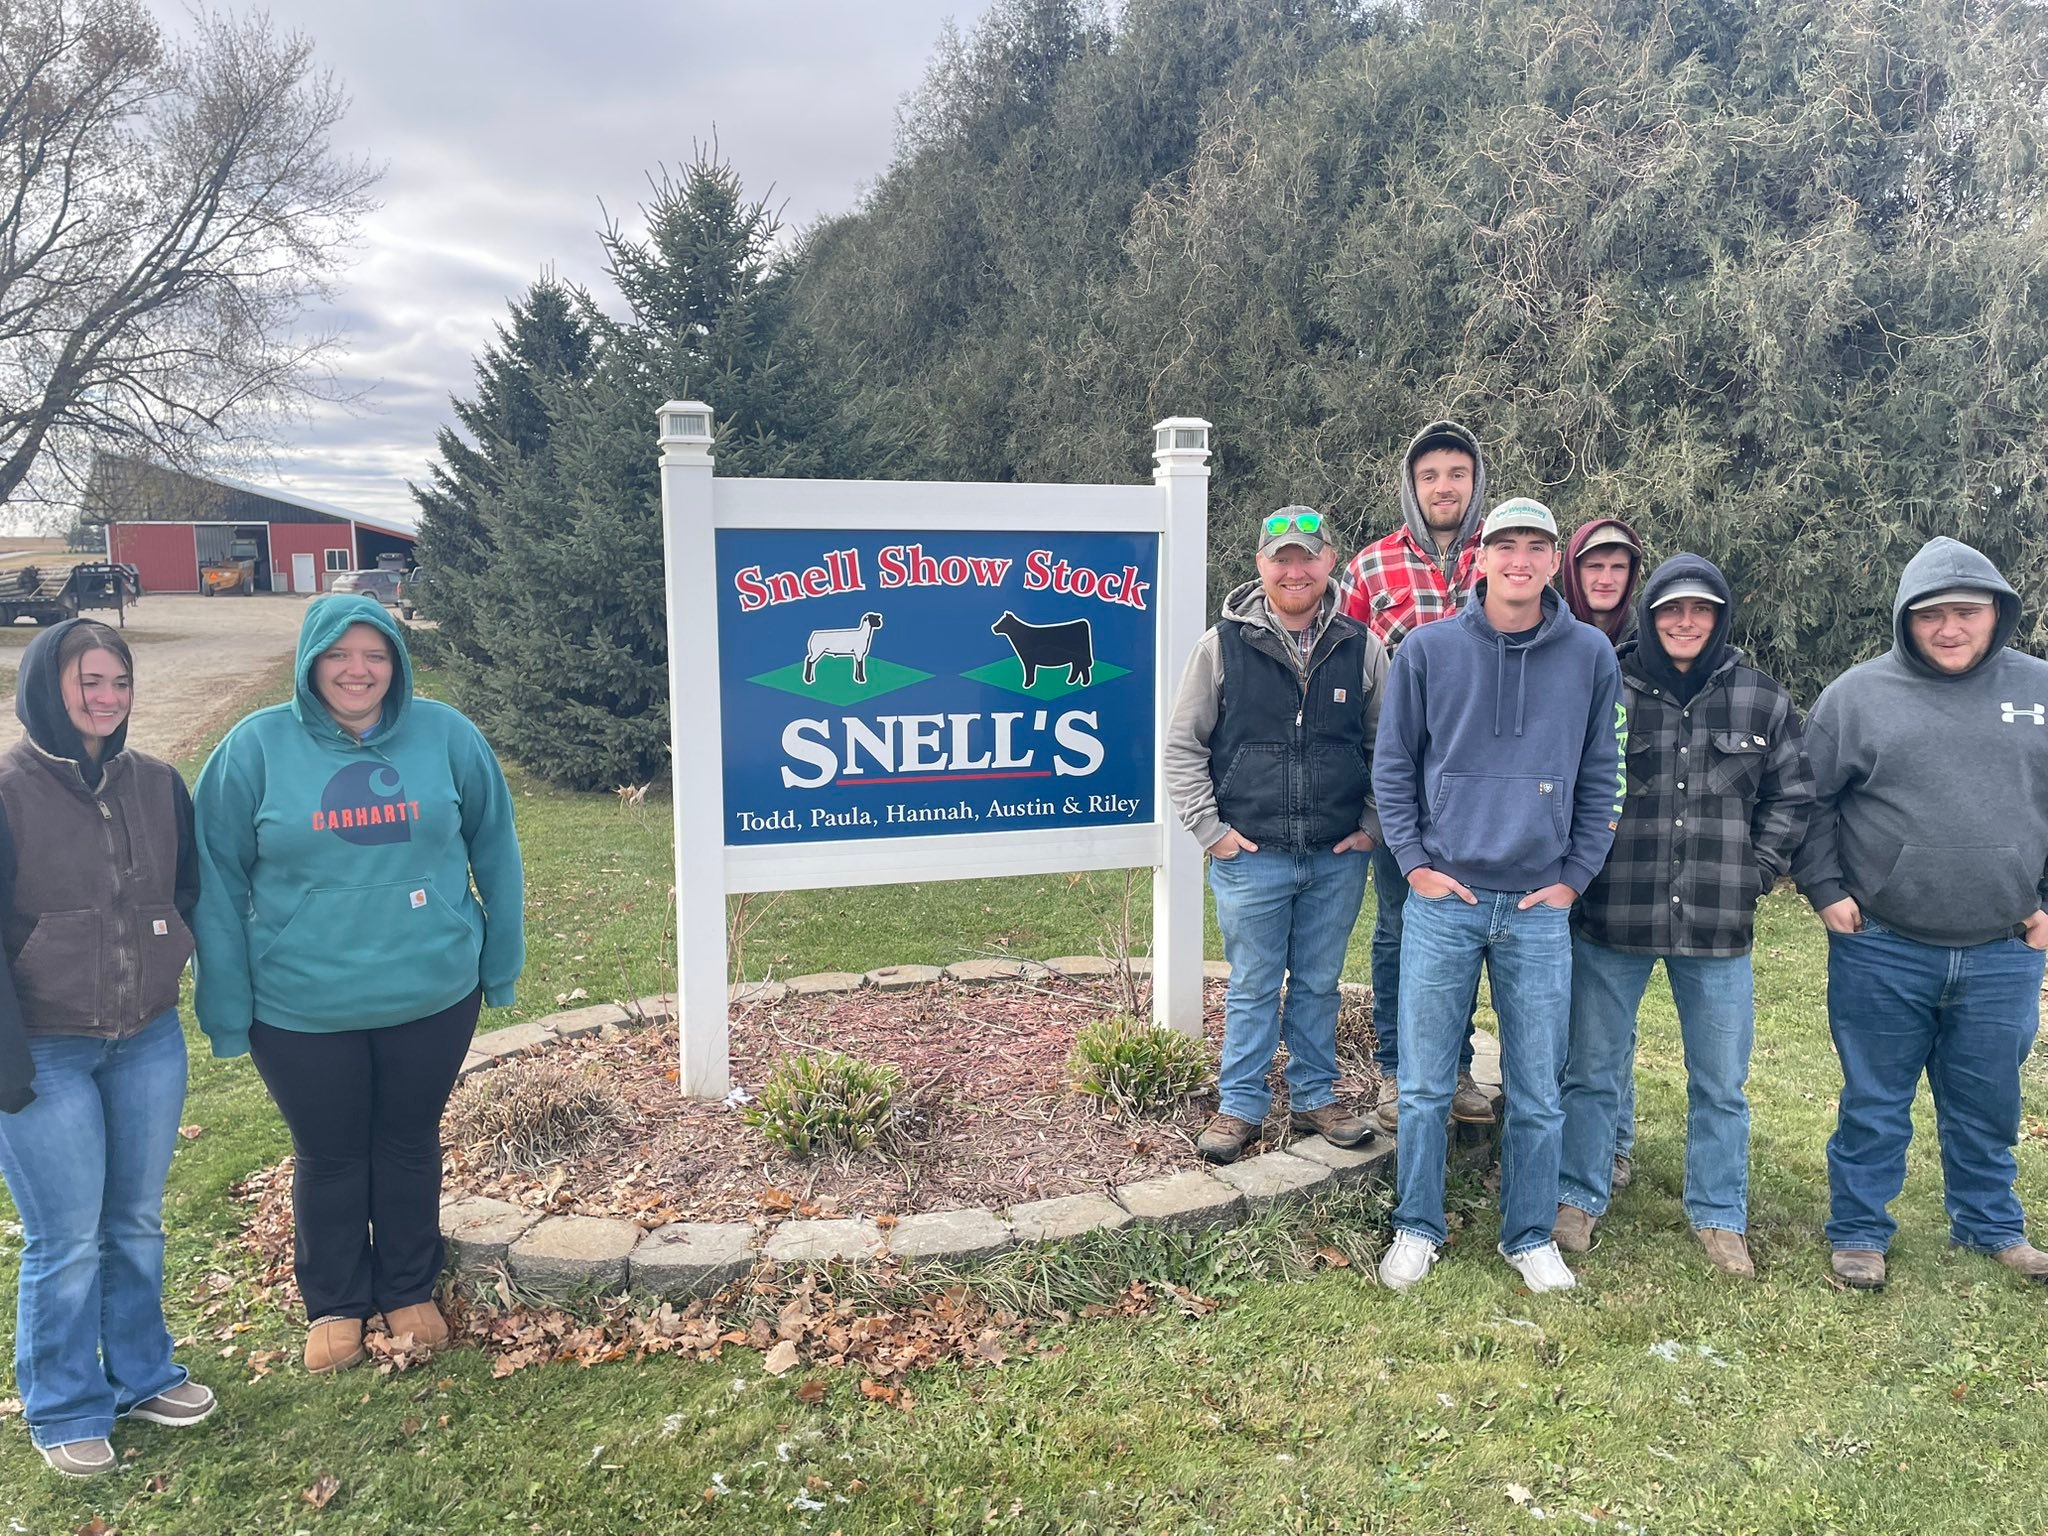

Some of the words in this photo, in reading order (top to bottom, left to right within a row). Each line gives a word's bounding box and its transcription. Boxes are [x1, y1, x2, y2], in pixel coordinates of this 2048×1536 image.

[735, 548, 866, 612] Snell
[878, 543, 1012, 588] Show
[1023, 550, 1150, 610] Stock
[780, 710, 1105, 789] SNELL'S
[312, 801, 419, 831] CARHARTT
[737, 810, 802, 831] Todd,
[811, 806, 878, 827] Paula,
[886, 801, 979, 823] Hannah,
[986, 798, 1055, 818] Austin
[1063, 796, 1082, 814] &
[1089, 794, 1140, 817] Riley
